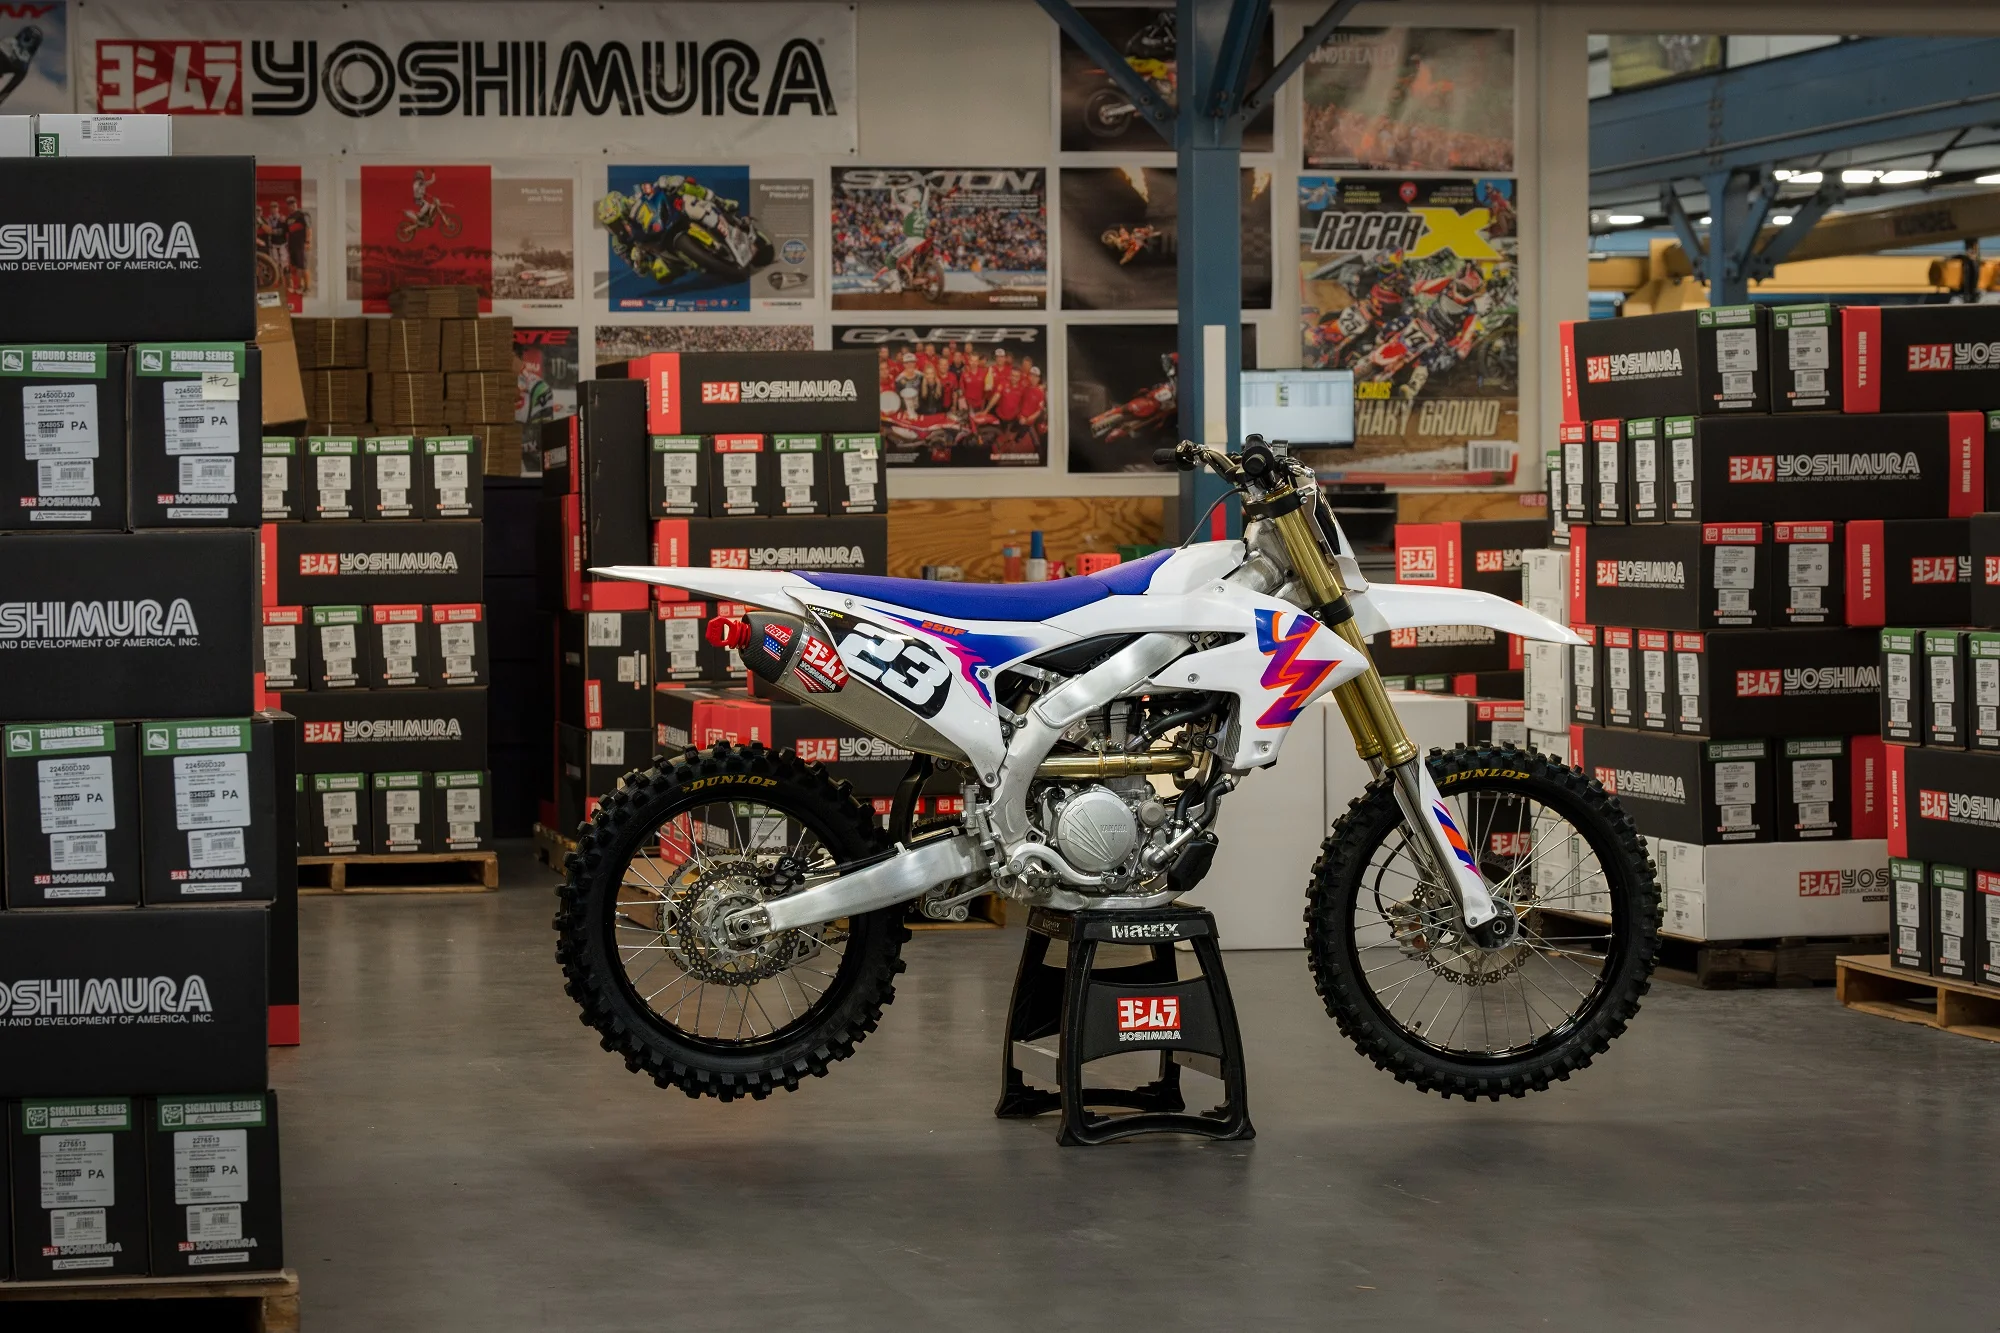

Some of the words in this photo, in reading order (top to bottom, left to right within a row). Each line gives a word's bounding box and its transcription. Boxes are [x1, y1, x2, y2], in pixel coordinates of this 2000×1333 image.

[100, 43, 238, 113] ヨシムラ
[252, 38, 838, 117] YOSHIMURA
[840, 170, 1038, 190] SEXTON
[22, 262, 103, 271] DEVELOPMENT
[107, 261, 121, 270] OF
[124, 261, 176, 271] AMERICA,
[180, 260, 202, 269] INC.
[32, 350, 65, 361] ENDURO
[66, 351, 96, 361] SERIES
[171, 350, 204, 361] ENDURO
[205, 351, 235, 361] SERIES
[1909, 344, 1952, 371] ヨシムラ
[1587, 356, 1610, 383] ヨシムラ
[1610, 348, 1682, 376] YOSHIMURA
[206, 374, 237, 388] #2
[703, 382, 739, 403] ヨシムラ
[741, 379, 857, 397] YOSHIMURA
[211, 416, 228, 425] PA
[1418, 400, 1500, 436] GROUND
[71, 421, 88, 431] PA
[1730, 456, 1774, 482] ヨシムラ
[1777, 452, 1920, 476] YOSHIMURA
[38, 496, 101, 507] YOSHIMURA
[175, 494, 238, 504] YOSHIMURA
[1737, 527, 1756, 535] SERIES
[301, 555, 338, 574] ヨシムラ
[340, 551, 458, 570] YOSHIMURA
[711, 549, 748, 568] ヨシムラ
[750, 546, 864, 564] YOSHIMURA
[1477, 551, 1502, 572] ヨシムラ
[1597, 560, 1617, 586] ヨシムラ
[1618, 560, 1685, 584] YOSHIMURA
[1912, 556, 1956, 584] ヨシムラ
[920, 619, 969, 636] 250F
[21, 640, 102, 649] DEVELOPMENT
[106, 639, 120, 648] OF
[123, 639, 175, 649] AMERICA,
[179, 638, 201, 647] INC.
[836, 622, 950, 705] 23
[799, 660, 836, 690] YOSHIMURA
[1737, 669, 1781, 697] ヨシムラ
[1784, 666, 1881, 690] YOSHIM
[1831, 687, 1874, 695] DEVELOPMENT
[39, 726, 74, 739] ENDURO
[75, 725, 104, 737] SERIES
[176, 726, 211, 738] ENDURO
[211, 725, 240, 737] SERIES
[305, 722, 342, 742] ヨシムラ
[343, 718, 462, 738] YOSHIMURA
[798, 739, 837, 762] ヨシムラ
[49, 764, 90, 773] 224500D320
[690, 774, 778, 792] DUNLOP
[1445, 768, 1530, 785] DUNLOP
[1617, 769, 1685, 799] YOSHIMURA
[86, 793, 104, 803] PA
[221, 789, 239, 800] PA
[1920, 790, 1948, 820] ヨシムラ
[1100, 824, 1127, 833] YAMAHA
[52, 872, 115, 884] YOSHIMURA
[188, 867, 251, 879] YOSHIMURA
[1799, 871, 1840, 896] ヨシムラ
[1112, 922, 1180, 939] Matrix
[9, 1018, 32, 1027] AND
[35, 1016, 116, 1026] DEVELOPMENT
[119, 1016, 134, 1024] OF
[137, 1015, 189, 1025] AMERICA,
[193, 1014, 214, 1023] INC.
[1118, 997, 1180, 1030] ヨシムラ
[1119, 1031, 1181, 1042] YOSHIMURA
[49, 1105, 97, 1117] SIGNATURE
[98, 1104, 127, 1115] SERIES
[184, 1102, 231, 1114] SIGNATURE
[232, 1100, 261, 1111] SERIES
[88, 1169, 105, 1179] PA
[222, 1165, 239, 1175] PA
[60, 1242, 122, 1255] YOSHIMURA
[196, 1237, 258, 1250] YOSHIMURA
